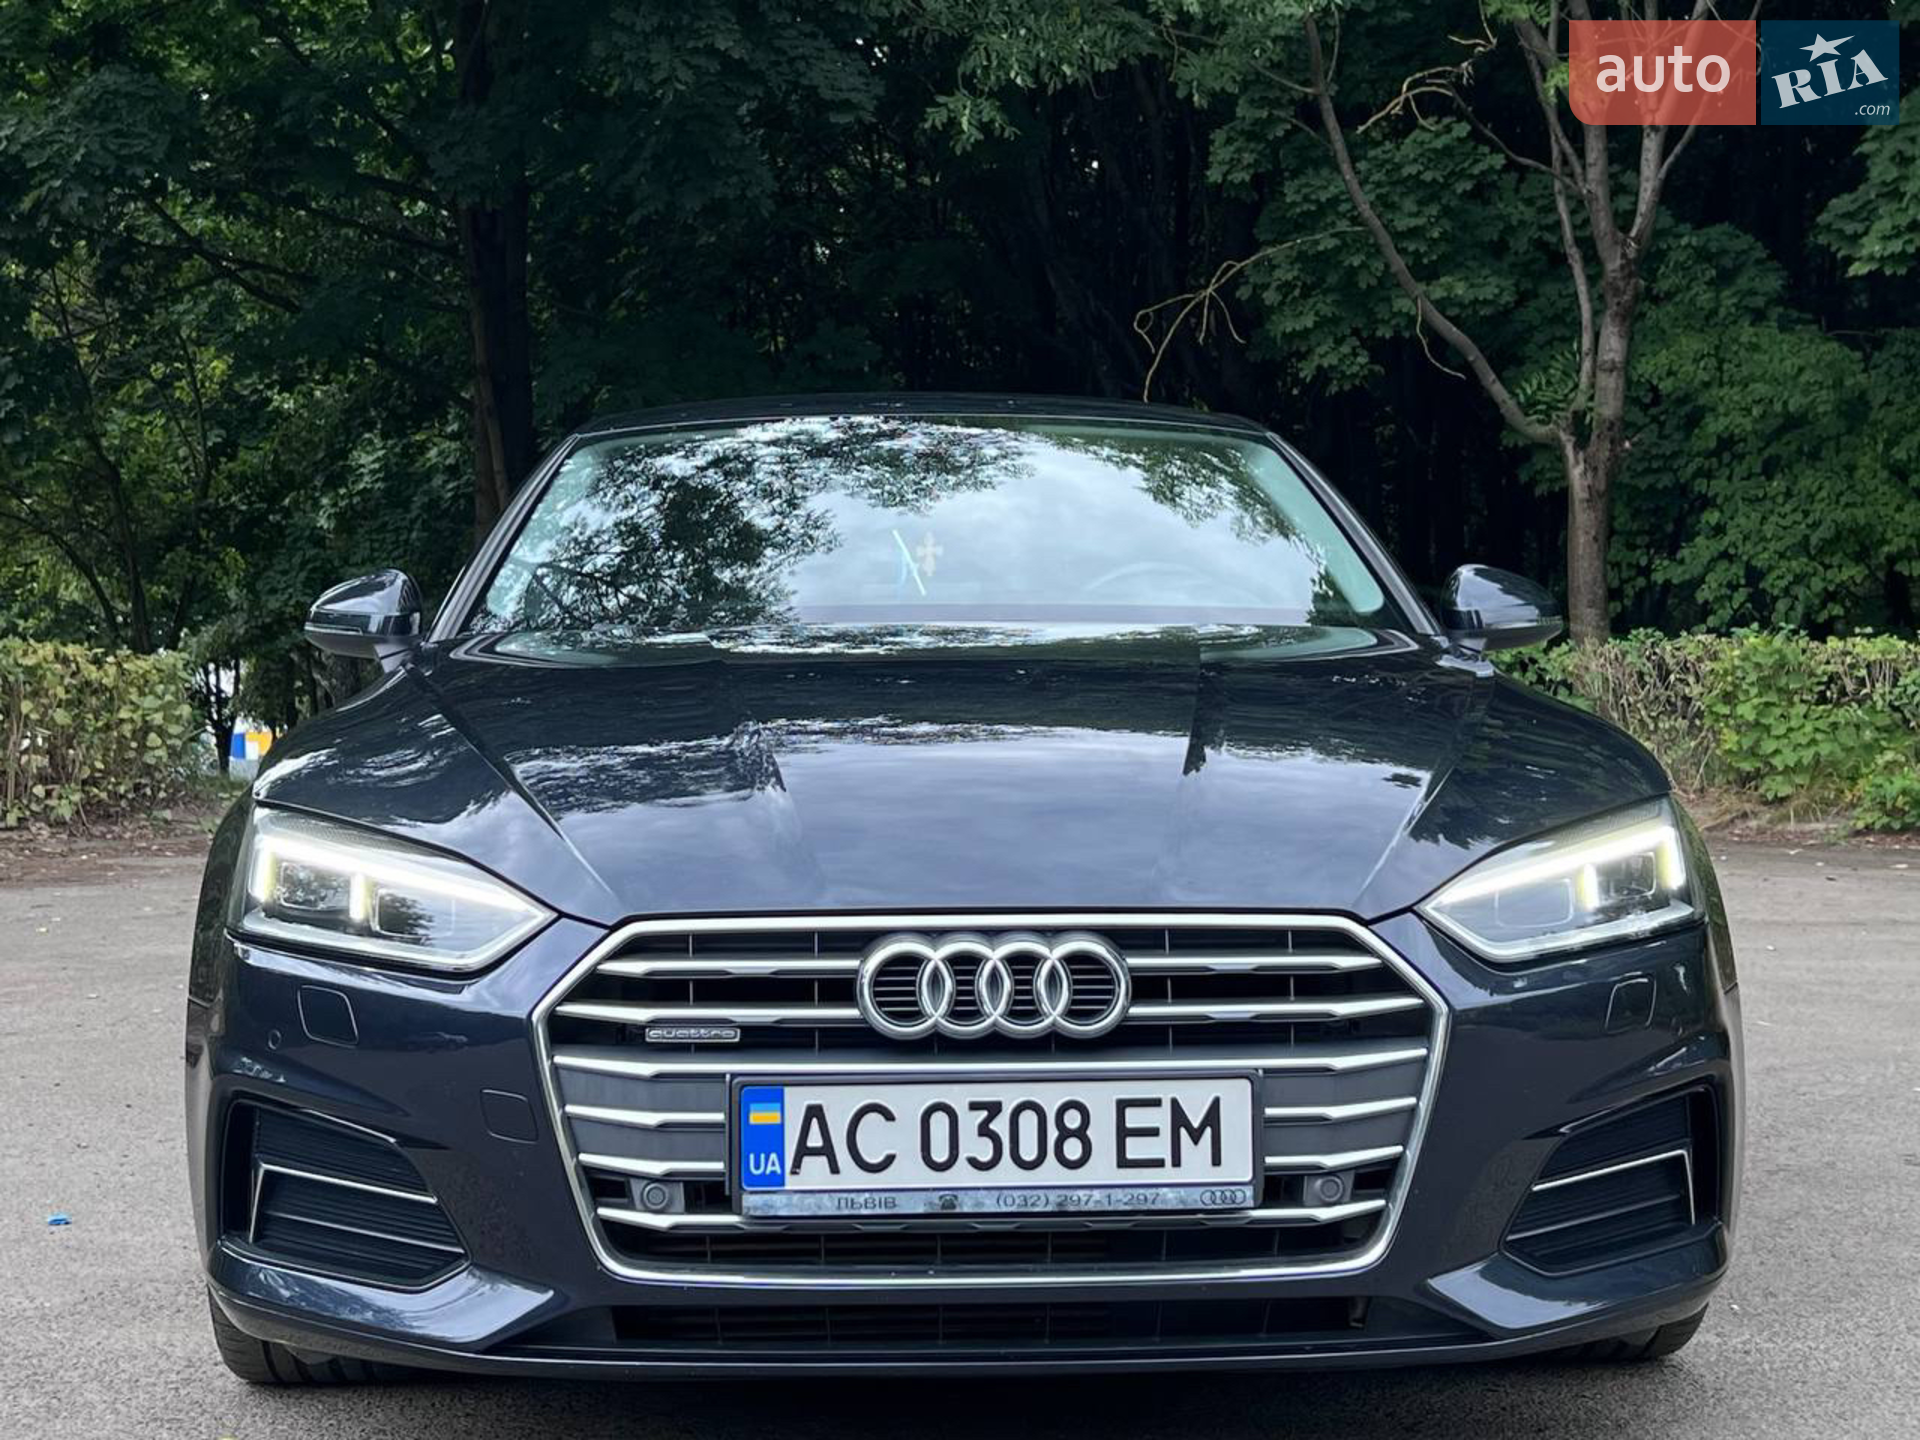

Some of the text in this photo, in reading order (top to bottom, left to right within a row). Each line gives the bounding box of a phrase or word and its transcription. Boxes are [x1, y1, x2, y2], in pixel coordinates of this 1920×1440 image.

[648, 1028, 737, 1039] quattro
[789, 1096, 1222, 1175] AC 0308 EM
[749, 1151, 782, 1176] UA
[996, 1193, 1050, 1209] (032)
